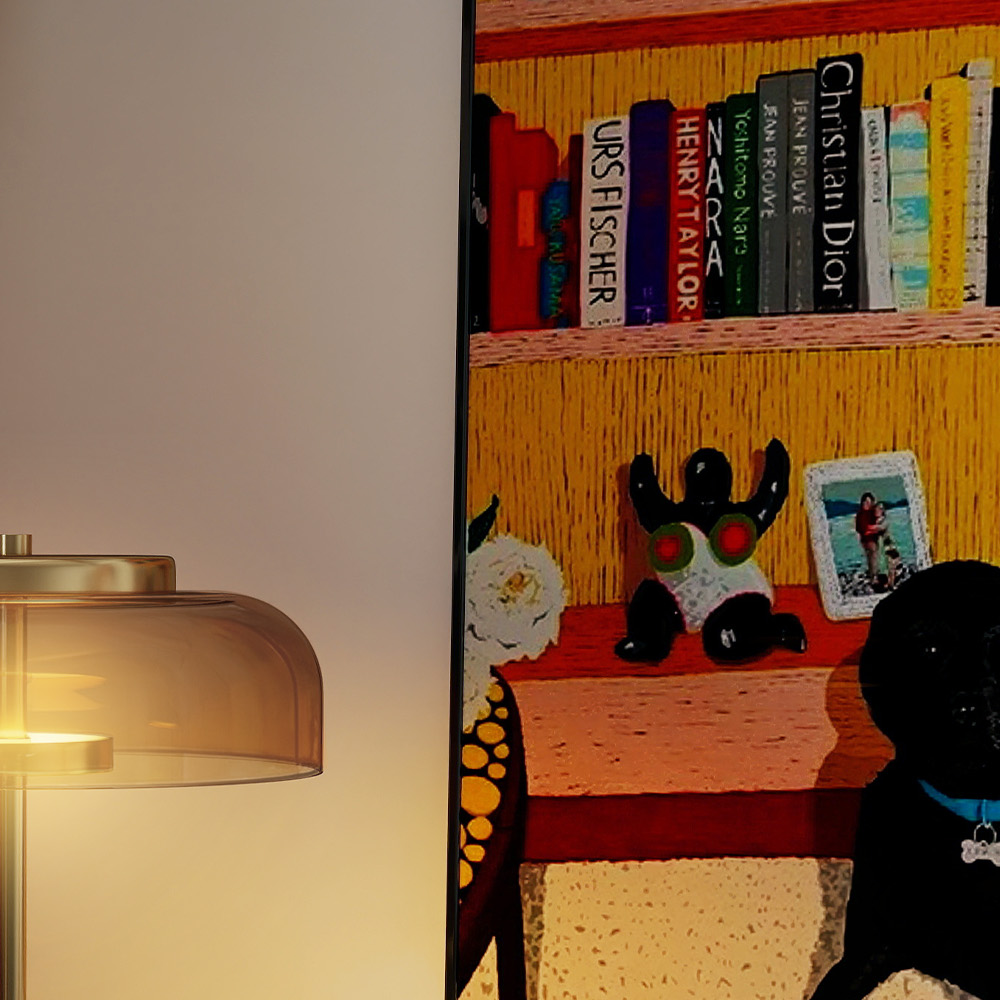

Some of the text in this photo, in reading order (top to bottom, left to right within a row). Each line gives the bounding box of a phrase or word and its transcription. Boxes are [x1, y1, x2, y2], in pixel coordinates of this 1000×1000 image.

[591, 120, 625, 180] URS
[762, 103, 779, 142] JEAN
[792, 98, 810, 138] JEAN
[676, 116, 701, 312] HENRY TAYLOR
[705, 117, 725, 278] NARA
[820, 60, 856, 298] Christian Dior
[588, 186, 624, 306] FISCHER
